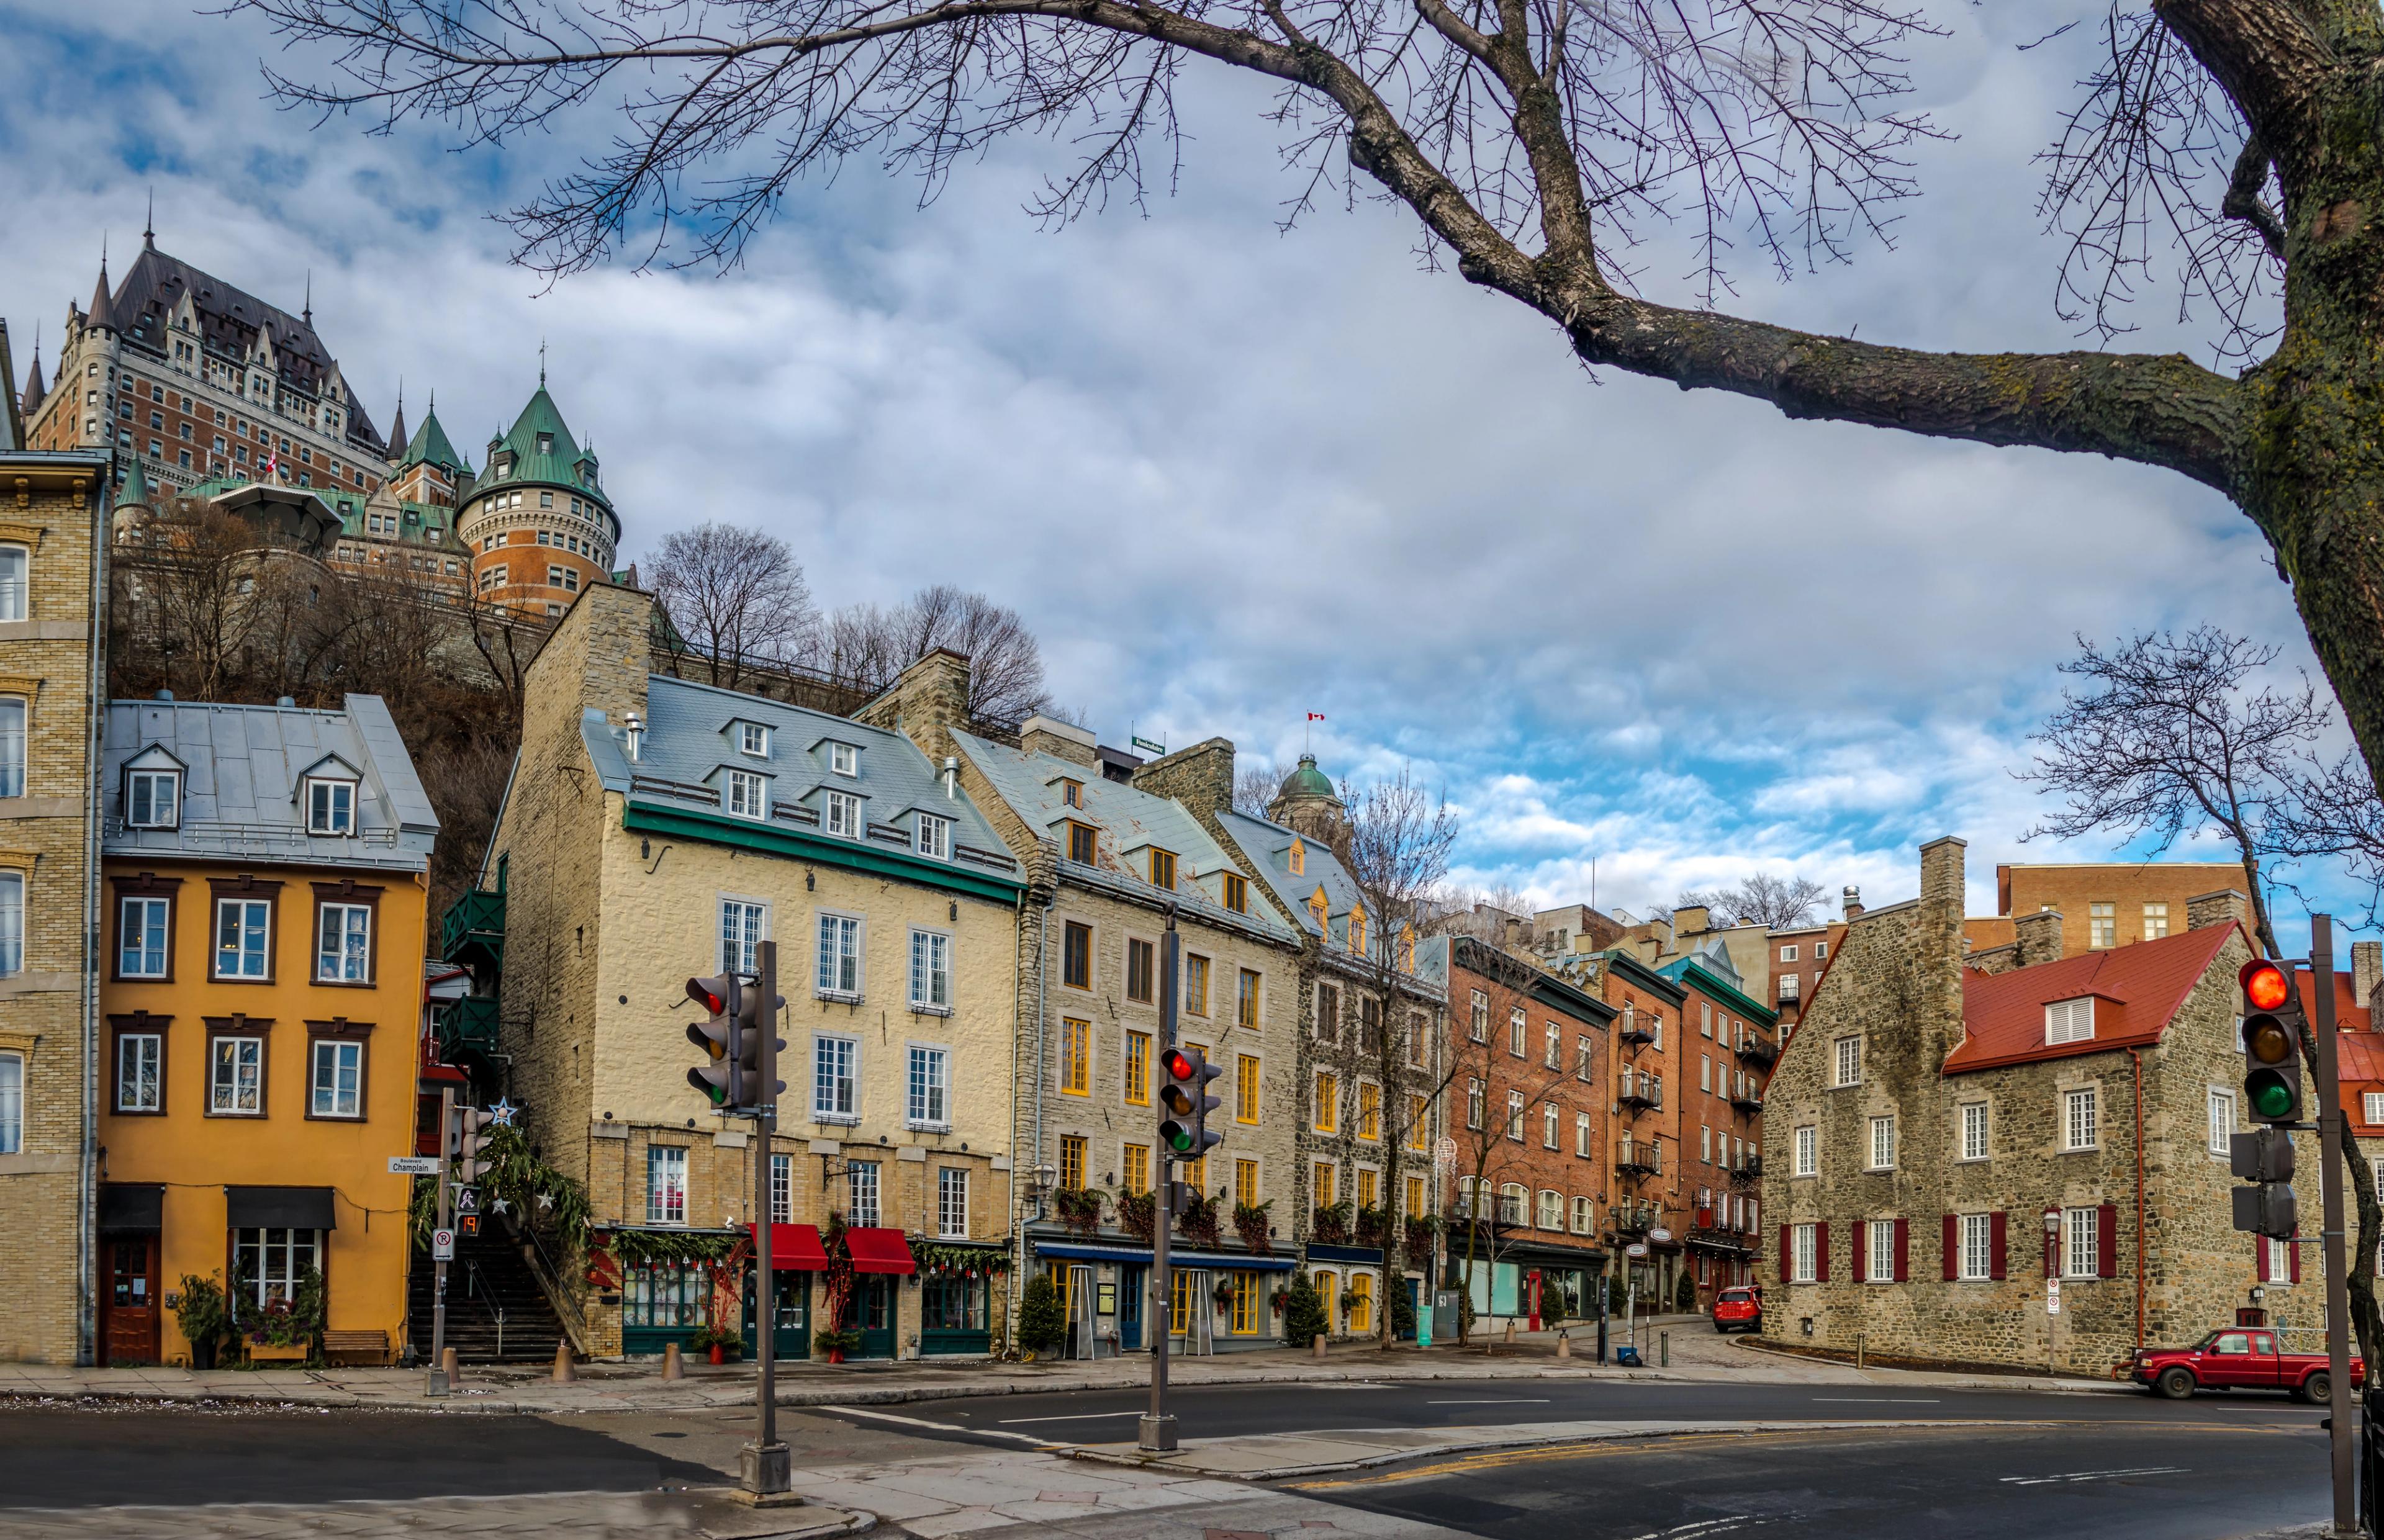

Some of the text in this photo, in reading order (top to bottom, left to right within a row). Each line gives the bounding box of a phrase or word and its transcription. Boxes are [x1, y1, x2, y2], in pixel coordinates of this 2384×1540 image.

[1136, 739, 1163, 753] Funiculaire
[393, 1163, 428, 1173] Champlain
[463, 1217, 476, 1232] 19
